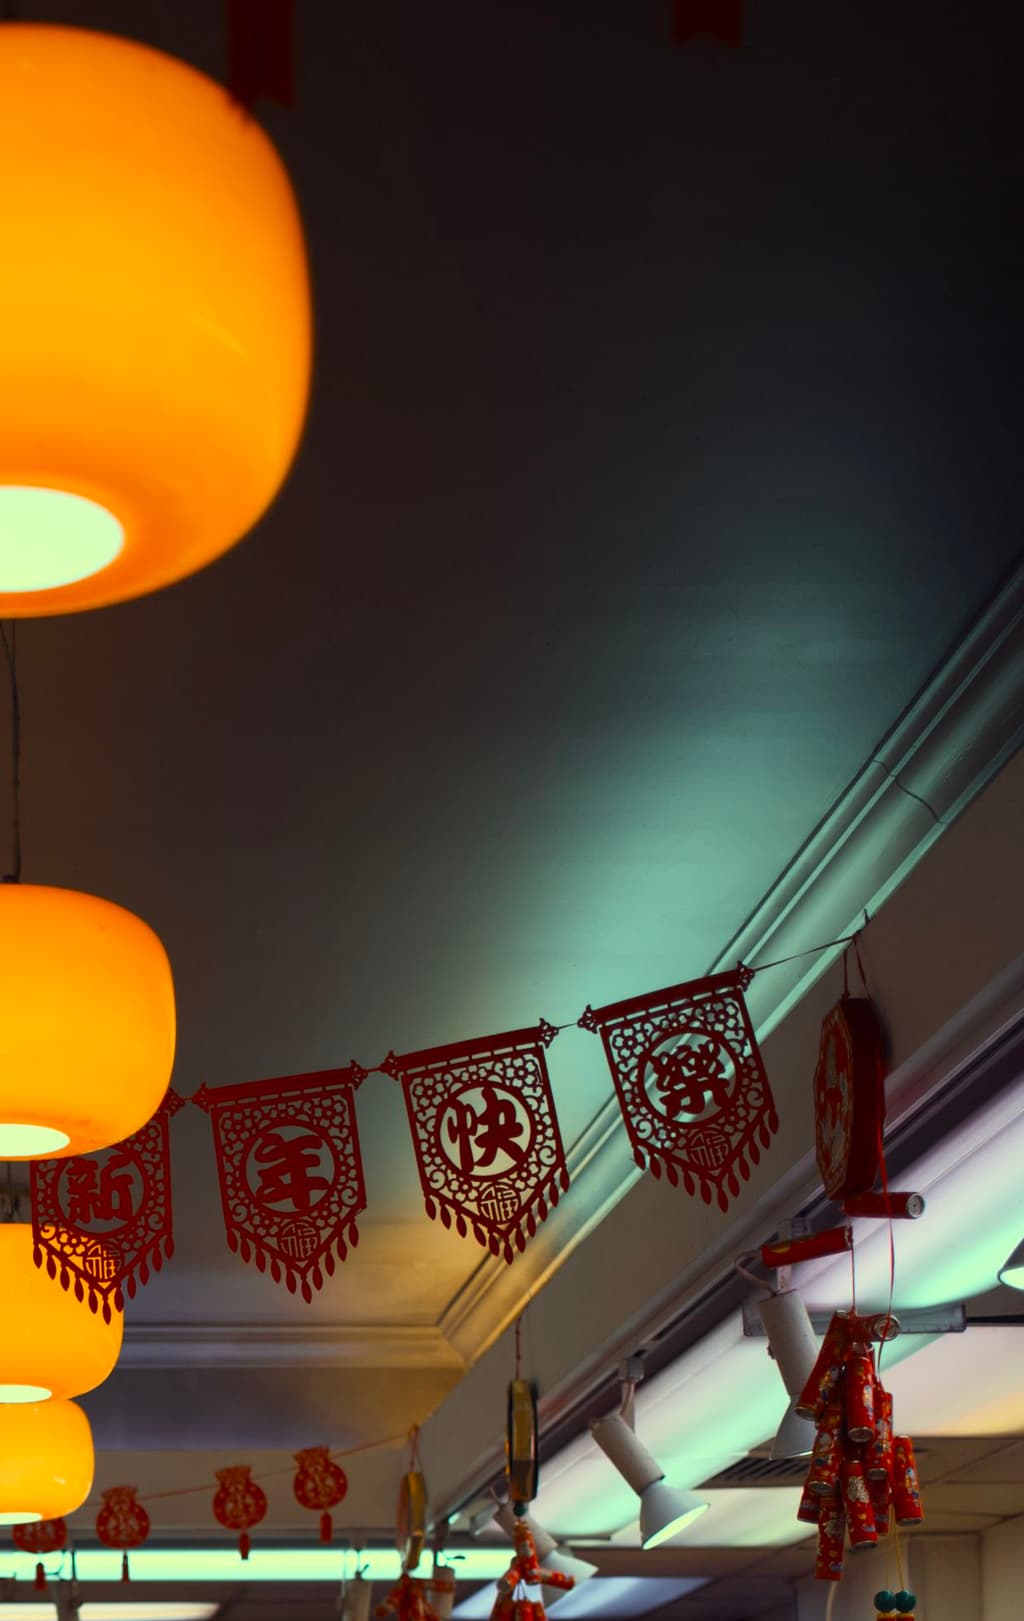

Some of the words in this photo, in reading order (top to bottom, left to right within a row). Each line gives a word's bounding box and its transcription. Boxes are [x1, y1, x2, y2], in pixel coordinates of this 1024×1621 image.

[448, 1087, 526, 1172] 快
[66, 1154, 133, 1222] 新
[255, 1134, 329, 1209] 年
